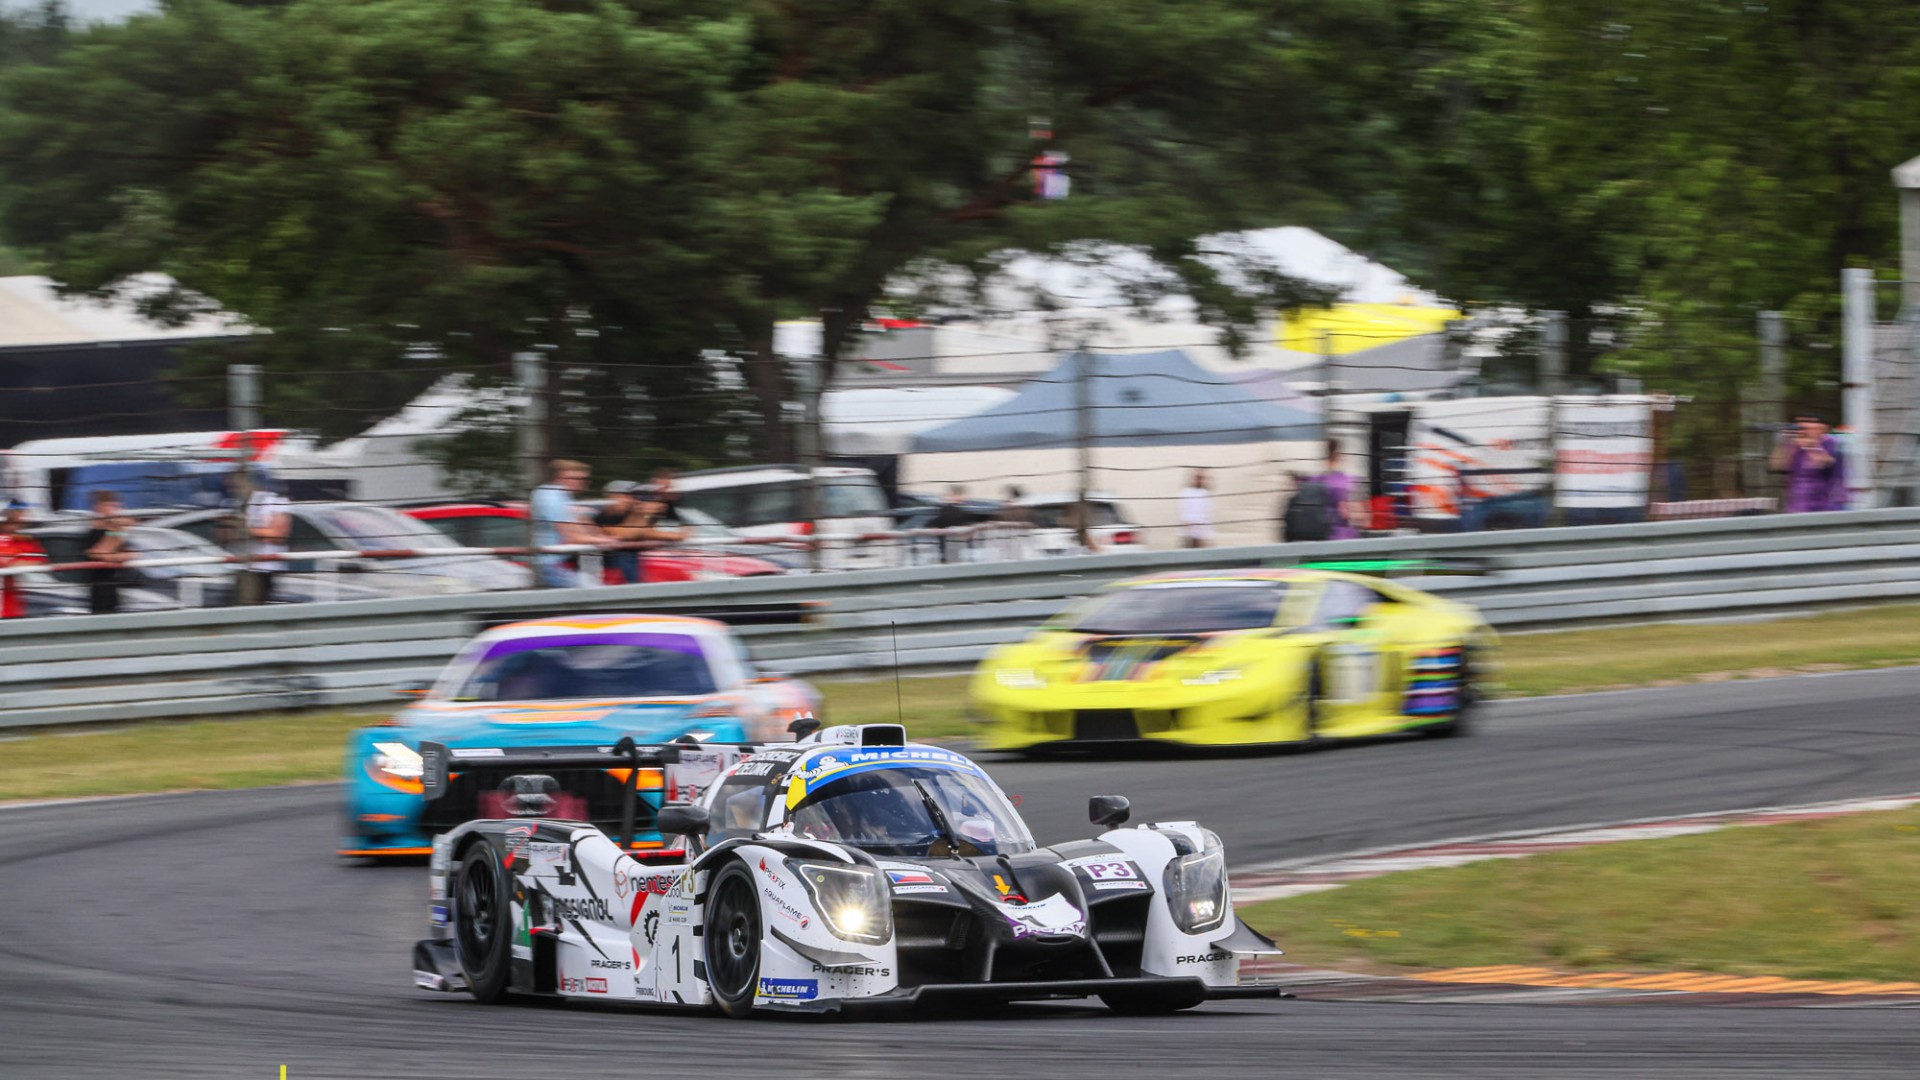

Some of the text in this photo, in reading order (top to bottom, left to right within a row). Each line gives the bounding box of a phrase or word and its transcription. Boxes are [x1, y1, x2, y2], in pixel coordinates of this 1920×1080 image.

[1087, 862, 1131, 878] P3
[764, 887, 803, 919] AQUAFLAME
[672, 934, 681, 984] 1
